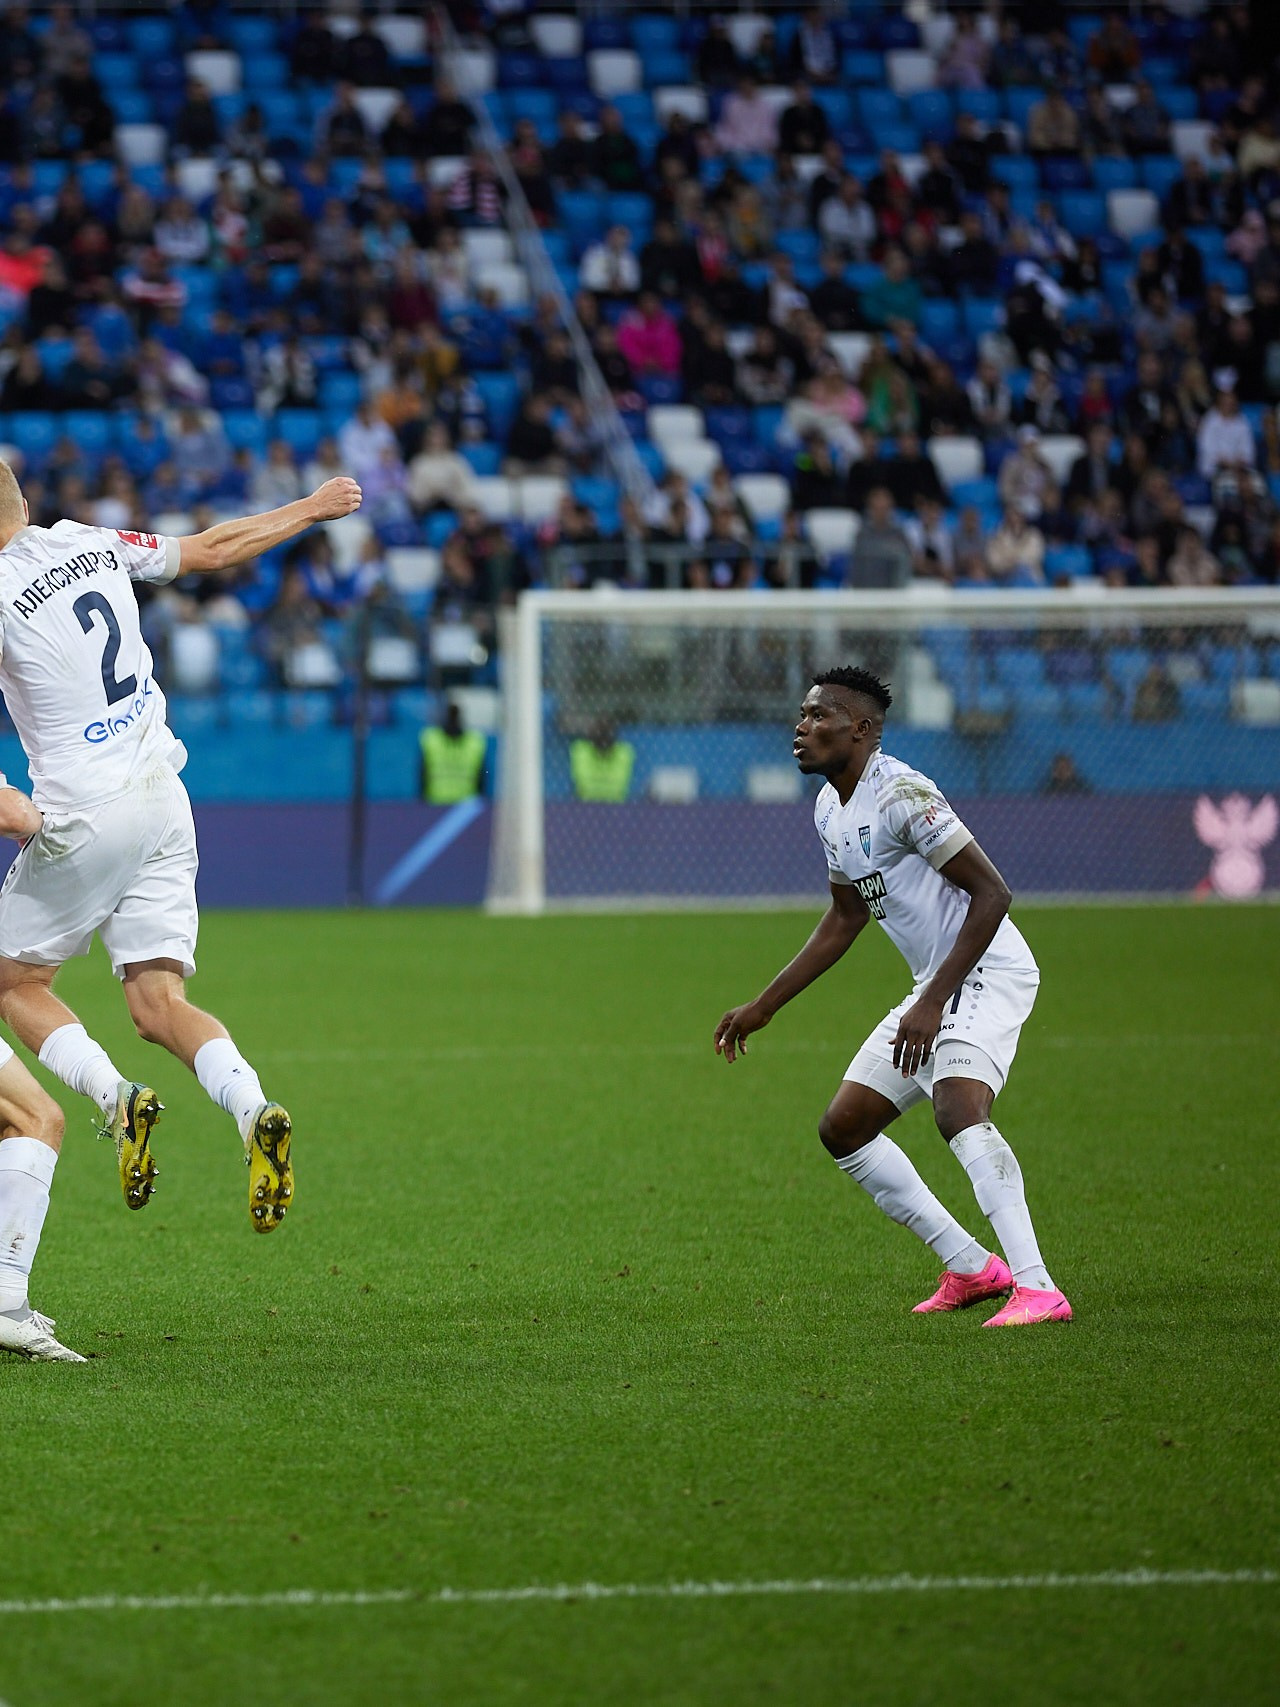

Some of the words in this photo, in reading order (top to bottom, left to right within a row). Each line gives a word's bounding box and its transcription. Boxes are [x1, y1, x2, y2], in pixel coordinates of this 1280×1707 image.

[72, 590, 138, 707] 2
[854, 874, 886, 900] АРИ
[947, 1058, 971, 1066] JAKO
